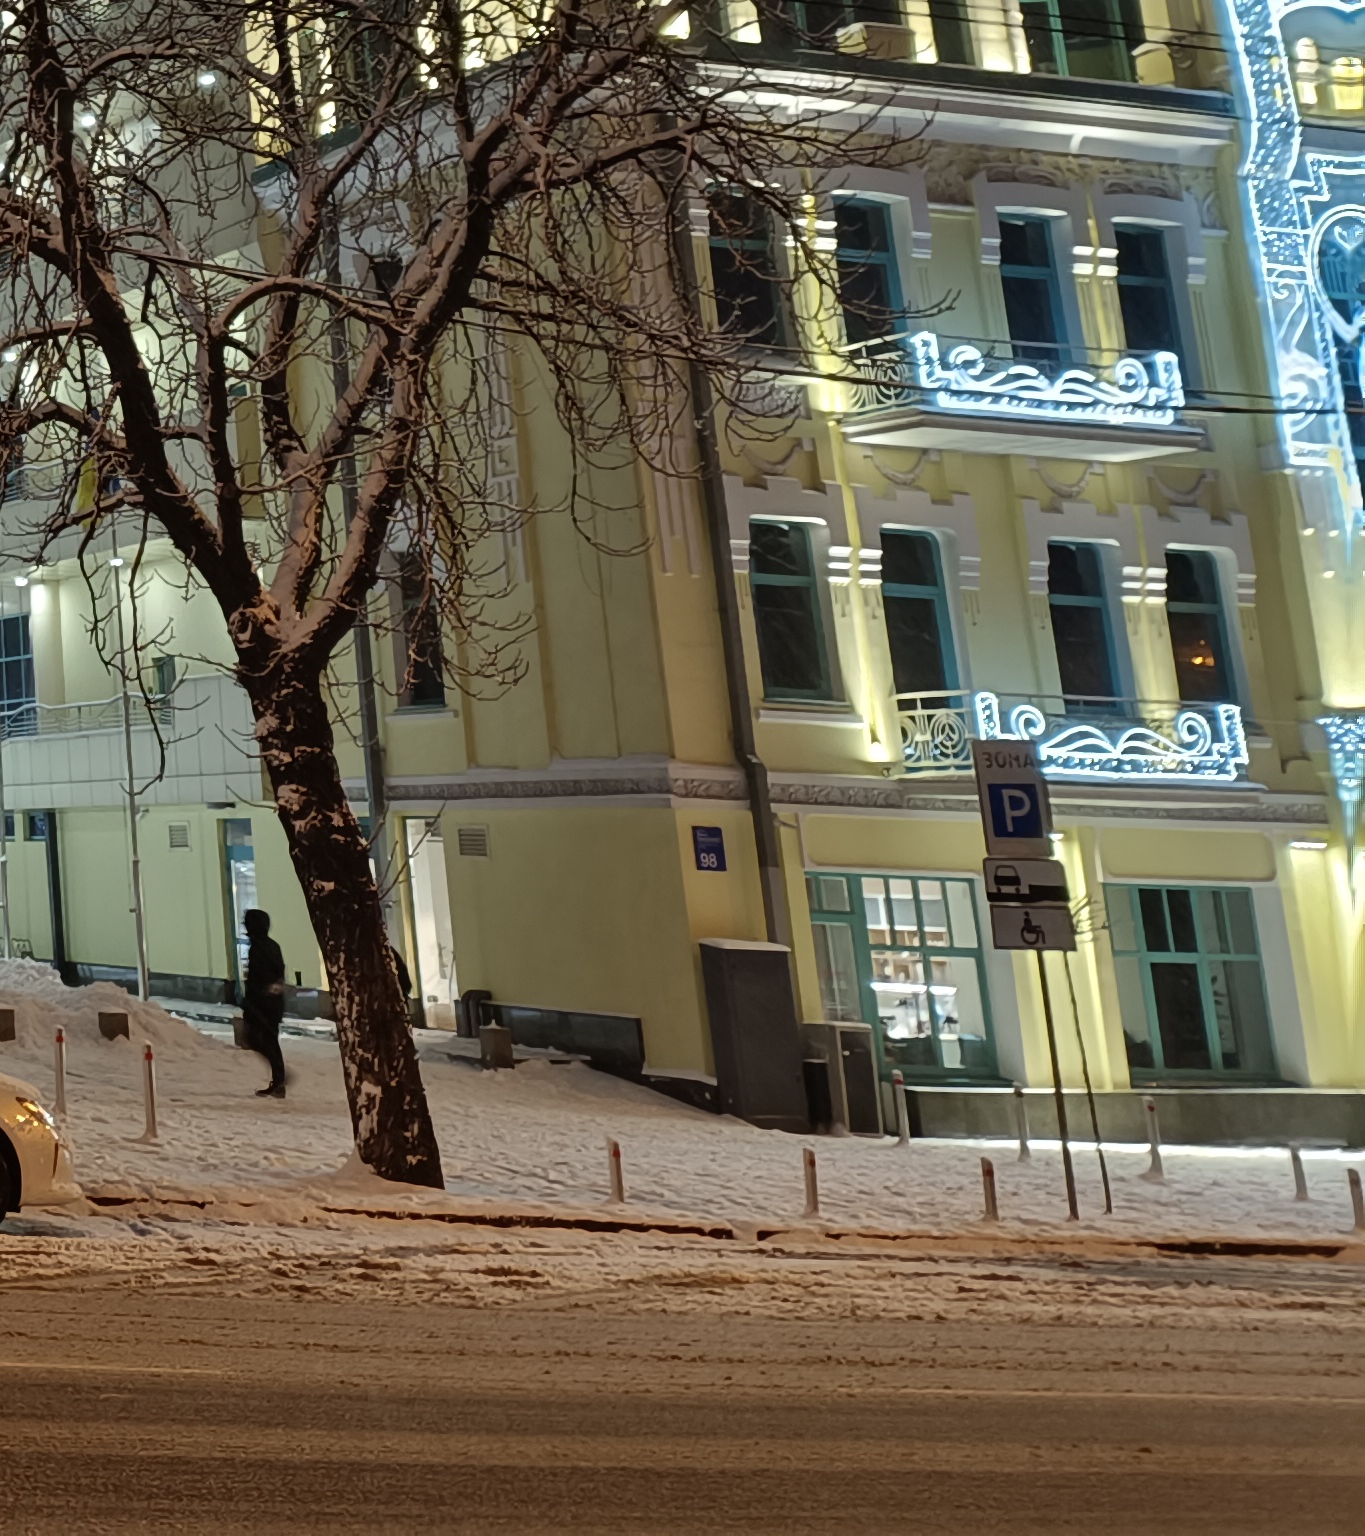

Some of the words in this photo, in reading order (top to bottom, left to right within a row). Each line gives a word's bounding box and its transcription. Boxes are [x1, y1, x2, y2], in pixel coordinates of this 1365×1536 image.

[982, 751, 1034, 769] ЗОНА
[1001, 789, 1031, 832] P
[700, 852, 717, 868] 98
